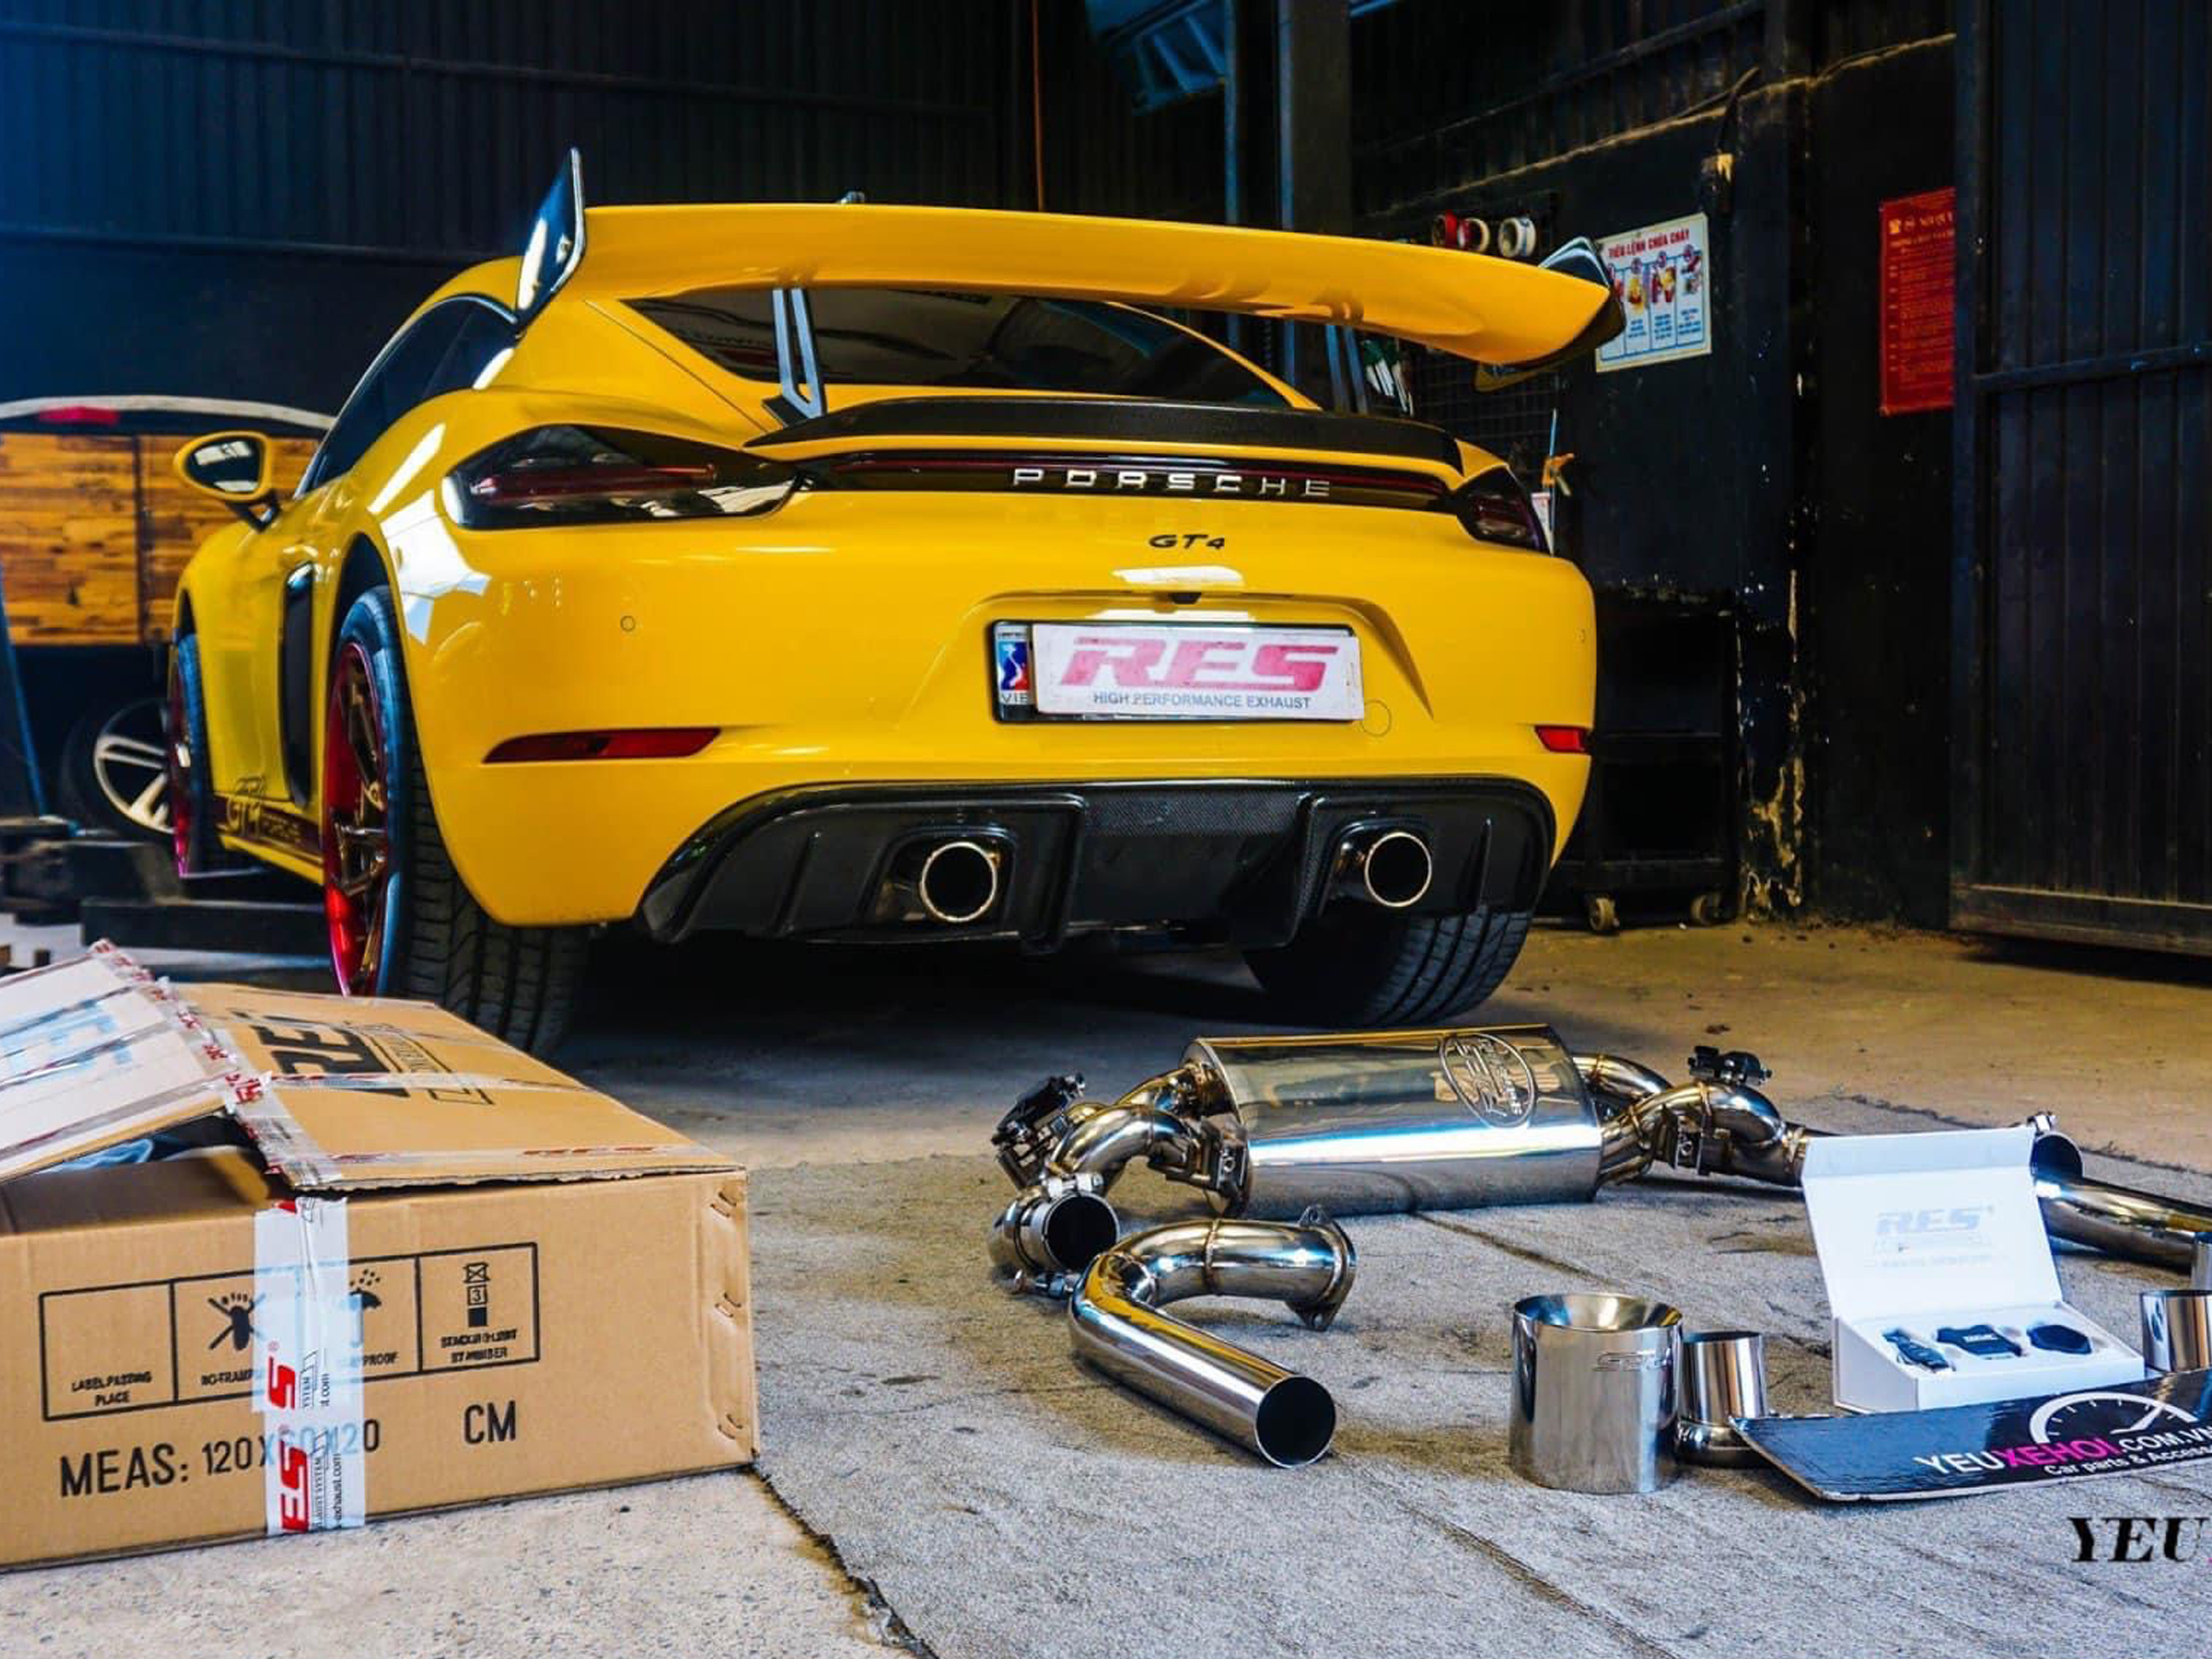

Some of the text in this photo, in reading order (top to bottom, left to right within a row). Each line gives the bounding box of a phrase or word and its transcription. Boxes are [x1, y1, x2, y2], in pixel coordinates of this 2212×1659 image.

[1013, 467, 1331, 497] PORSCHE
[1148, 533, 1225, 550] GT4
[1061, 636, 1338, 692] RES
[1092, 691, 1313, 710] HIGH PERFORMANCE EXHAUST
[1876, 1207, 1981, 1234] RES
[464, 1399, 517, 1446] CM
[60, 1443, 189, 1497] MEAS:
[2044, 1463, 2079, 1476] Car
